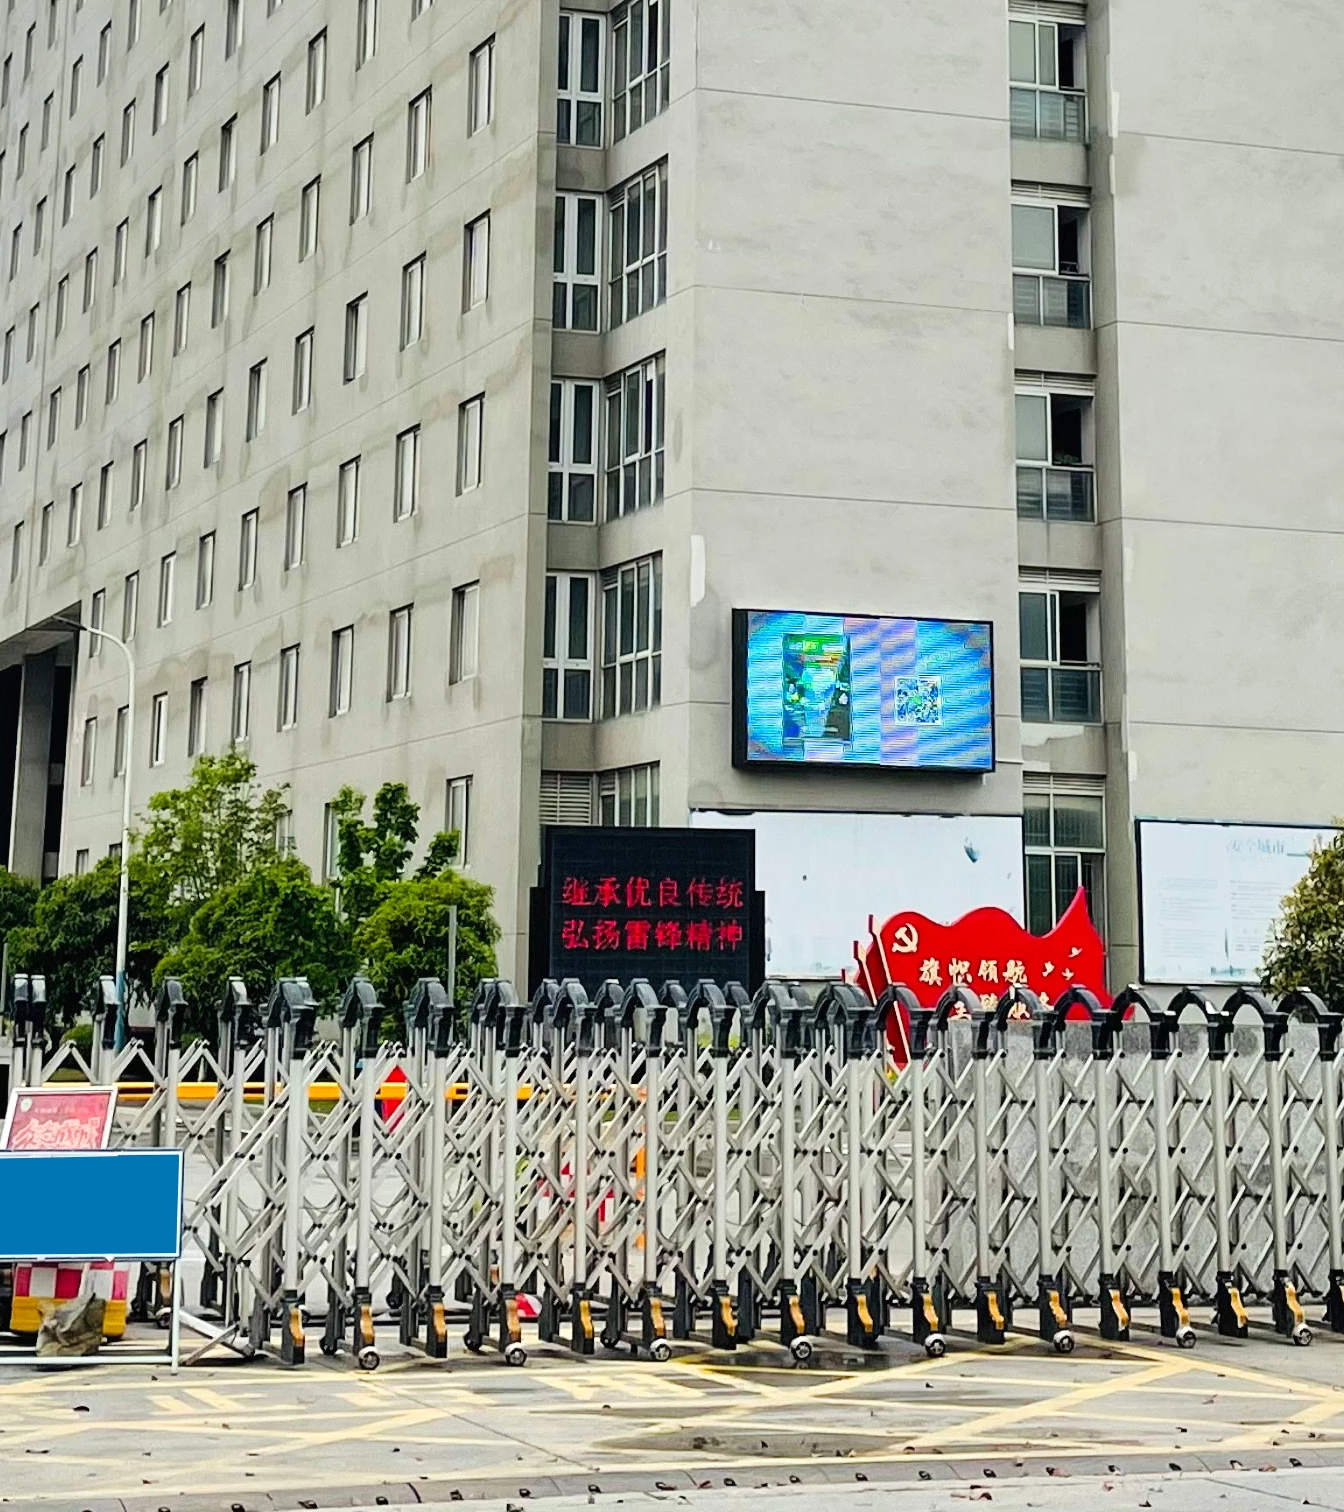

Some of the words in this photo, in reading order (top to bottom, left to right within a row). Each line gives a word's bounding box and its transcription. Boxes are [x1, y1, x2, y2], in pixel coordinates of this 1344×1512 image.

[561, 876, 744, 908] 继承优良传统
[561, 919, 743, 952] 弘扬雷锋精神
[919, 957, 1028, 986] 旗帜领航
